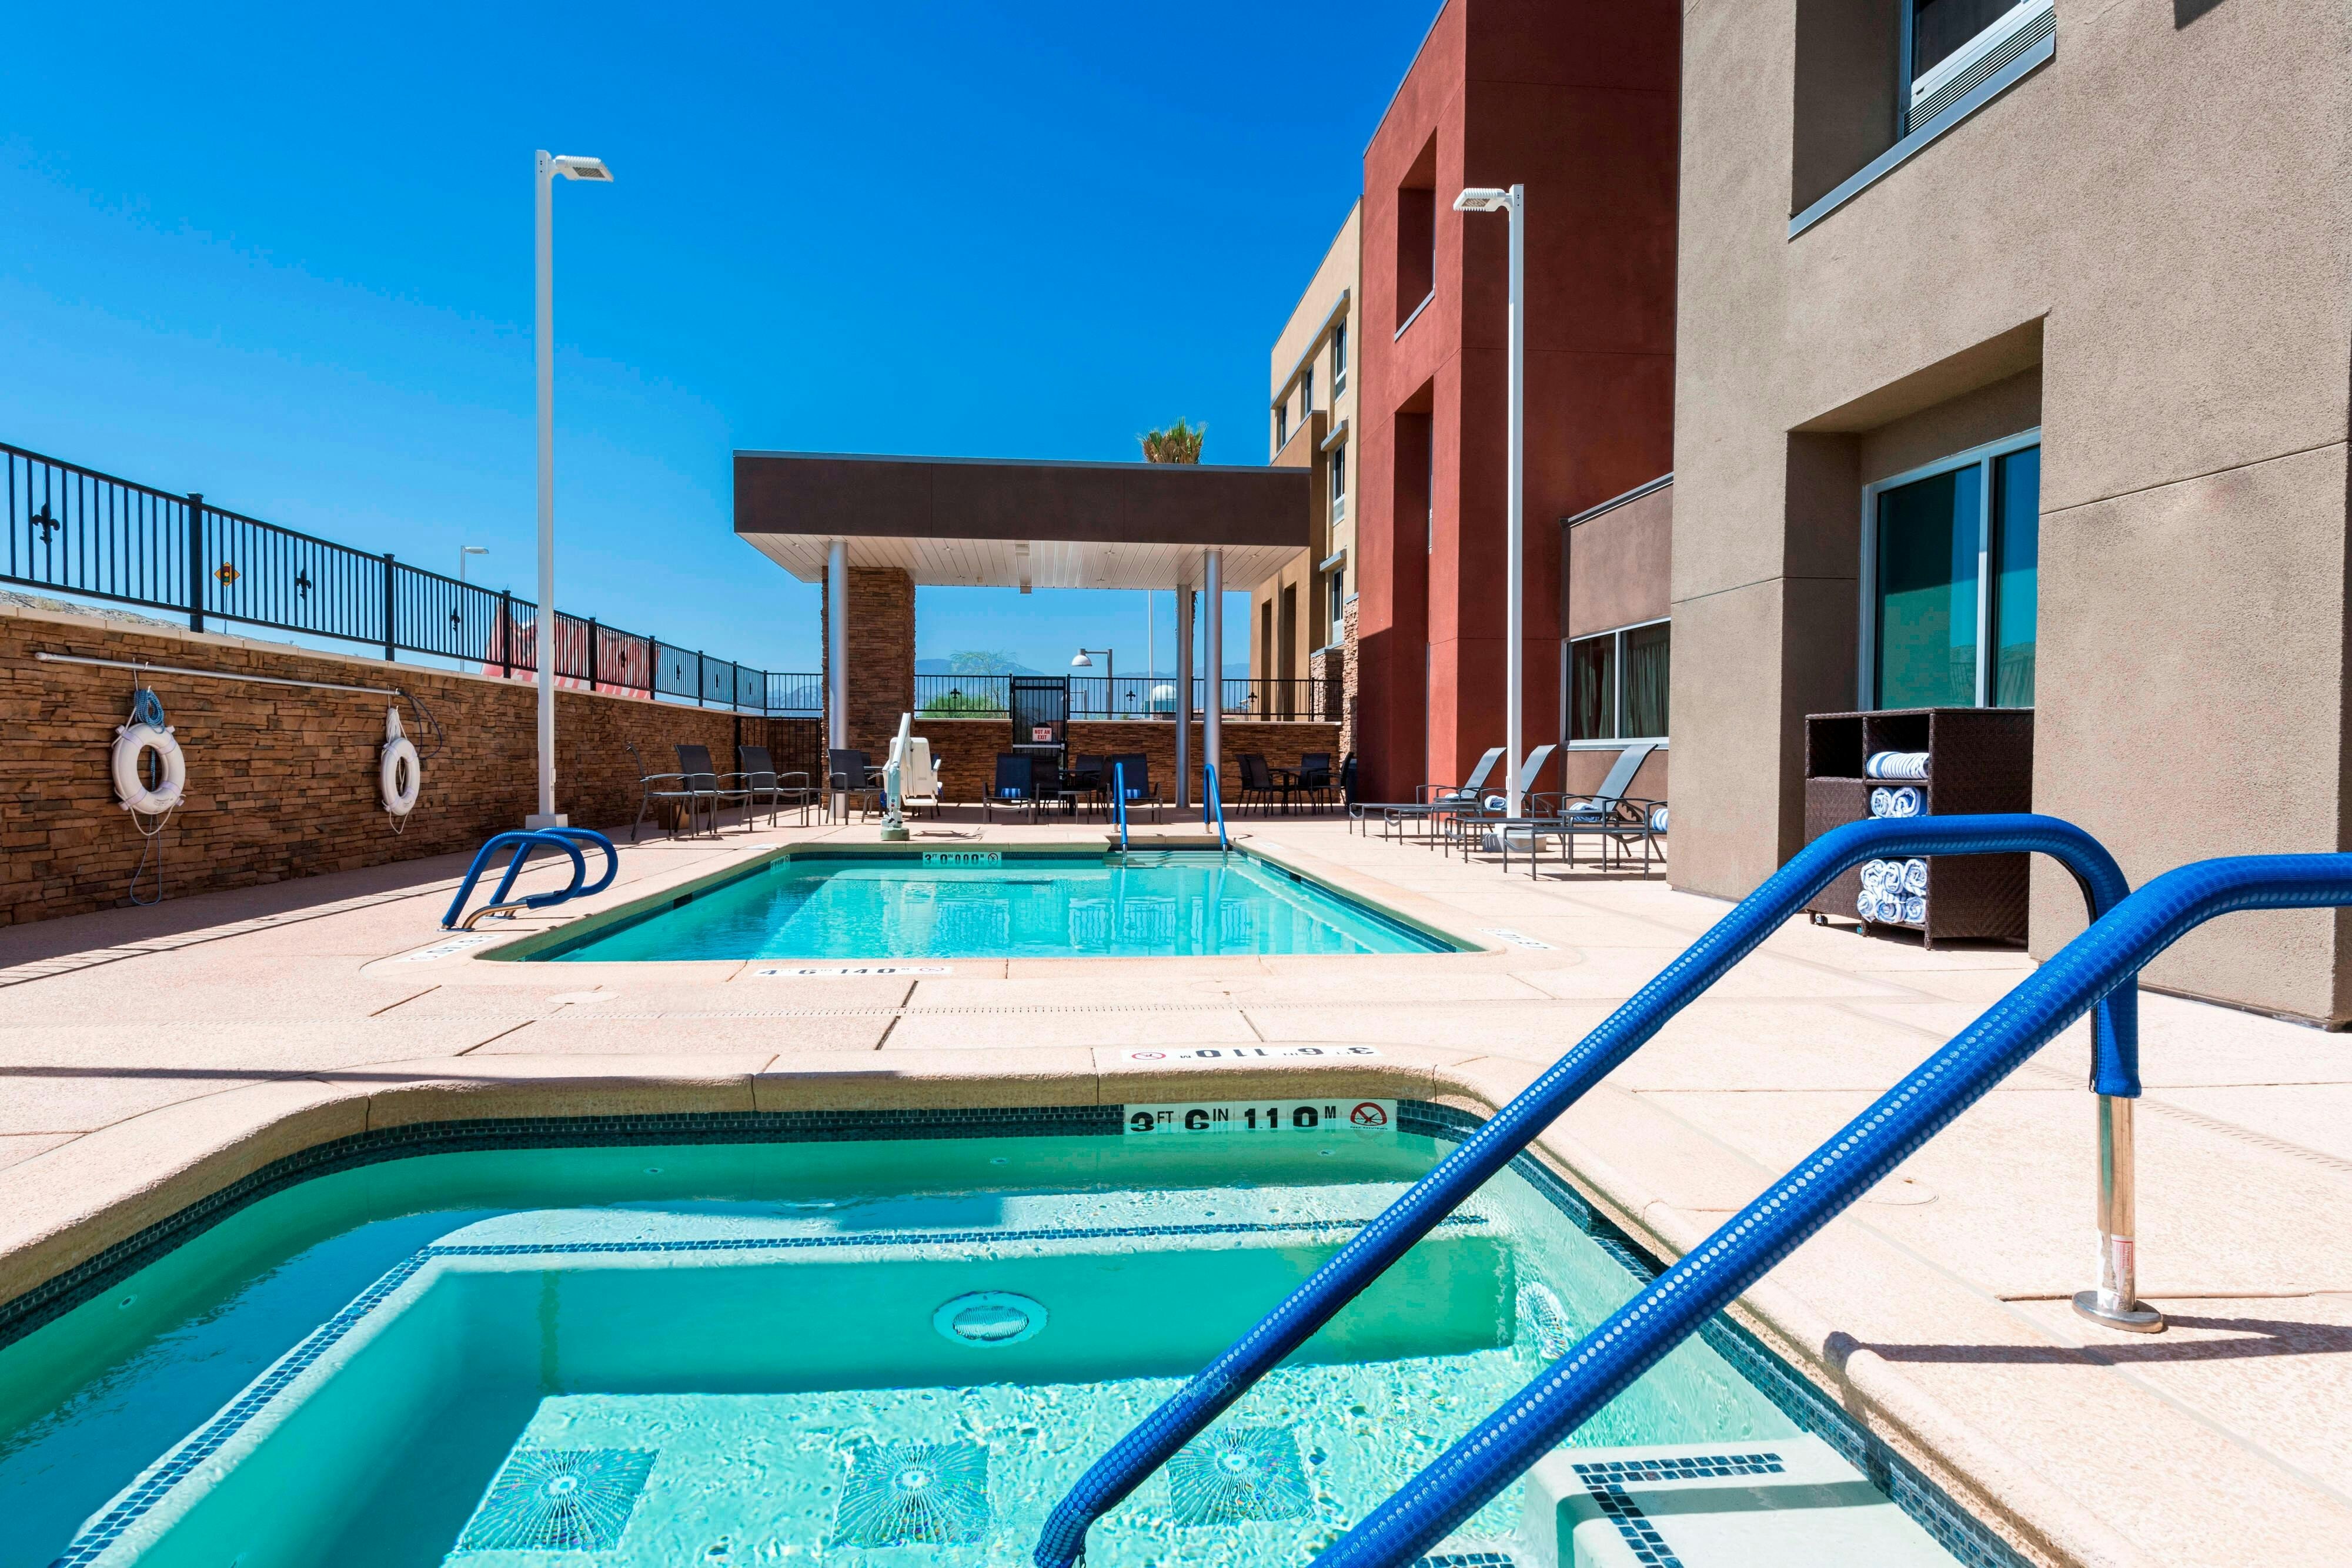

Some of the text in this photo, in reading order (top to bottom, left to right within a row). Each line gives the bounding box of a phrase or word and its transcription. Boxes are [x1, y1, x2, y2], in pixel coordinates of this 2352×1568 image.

[1130, 1112, 1155, 1132] 3
[1157, 1111, 1174, 1124] FT
[1213, 1108, 1228, 1121] IN
[1325, 1106, 1337, 1119] M
